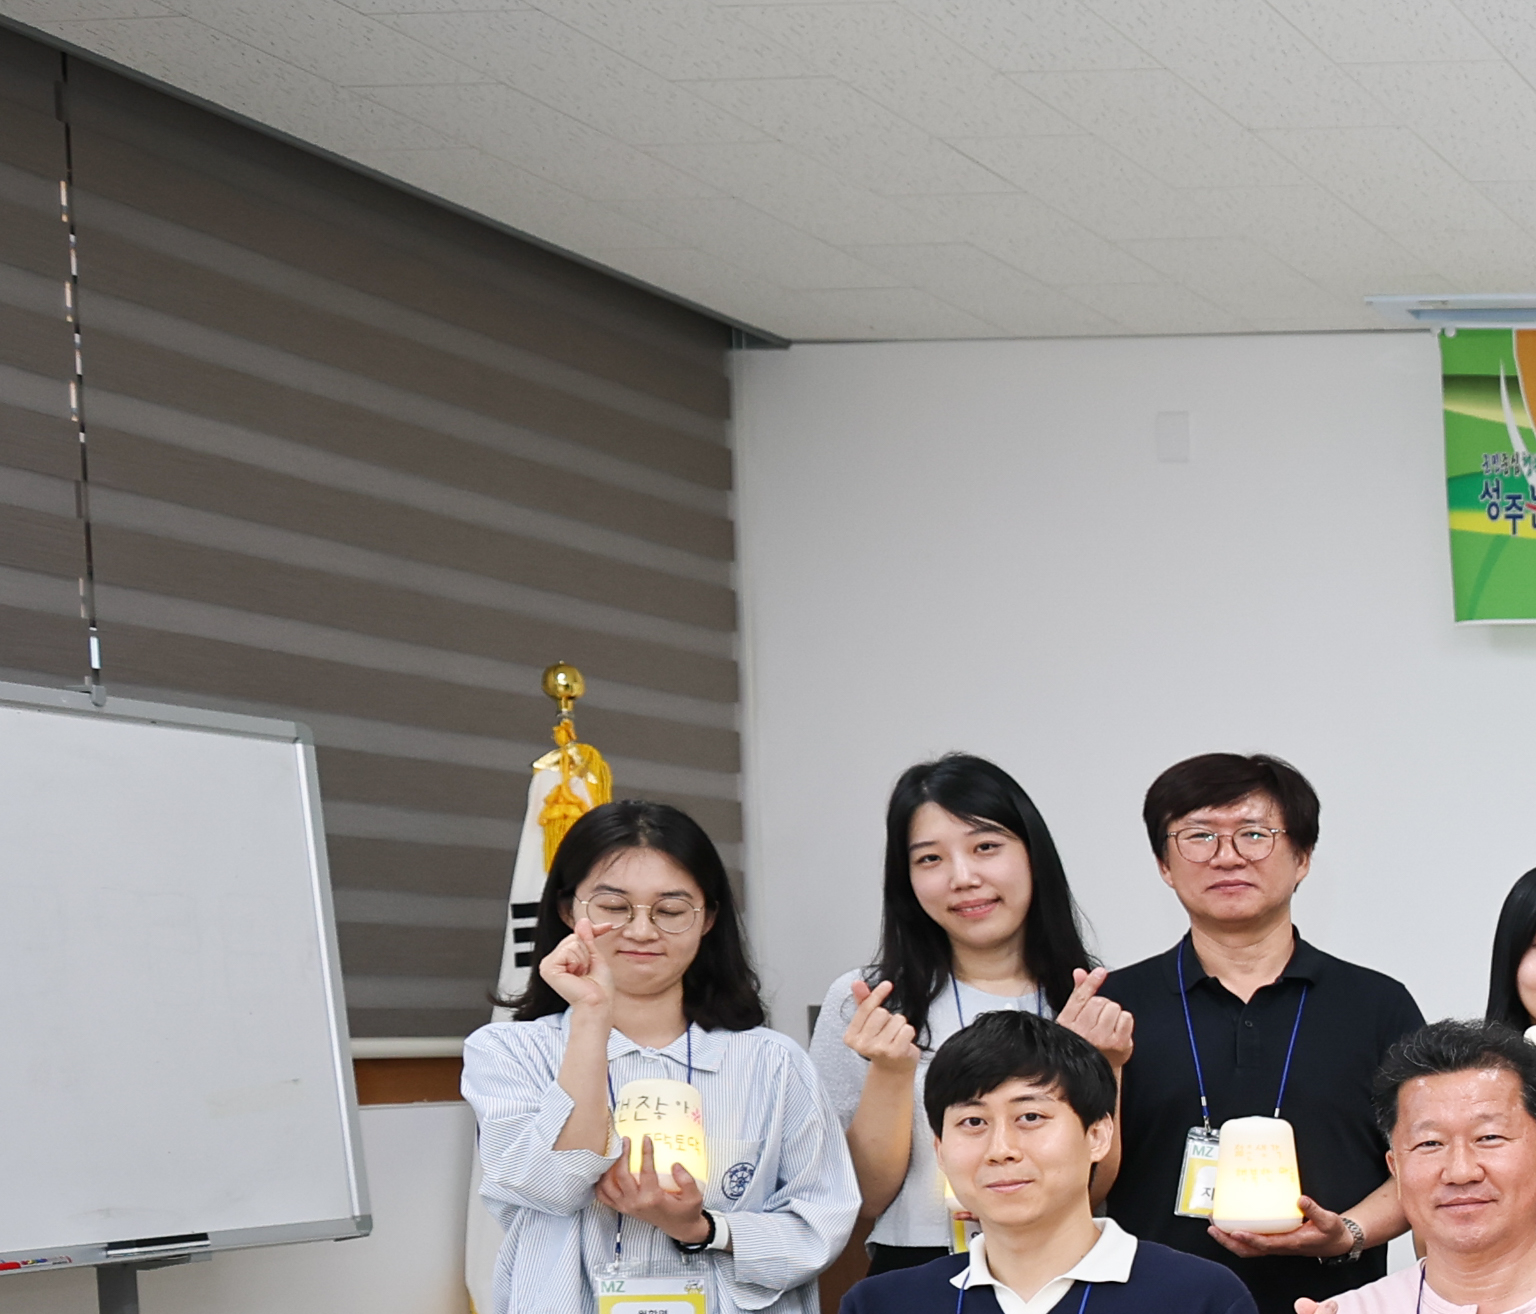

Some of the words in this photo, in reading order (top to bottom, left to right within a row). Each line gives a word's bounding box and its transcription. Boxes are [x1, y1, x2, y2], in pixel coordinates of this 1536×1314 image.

[645, 1132, 701, 1156] 닥토닥
[1192, 1144, 1213, 1158] MZ
[601, 1280, 625, 1293] MZ
